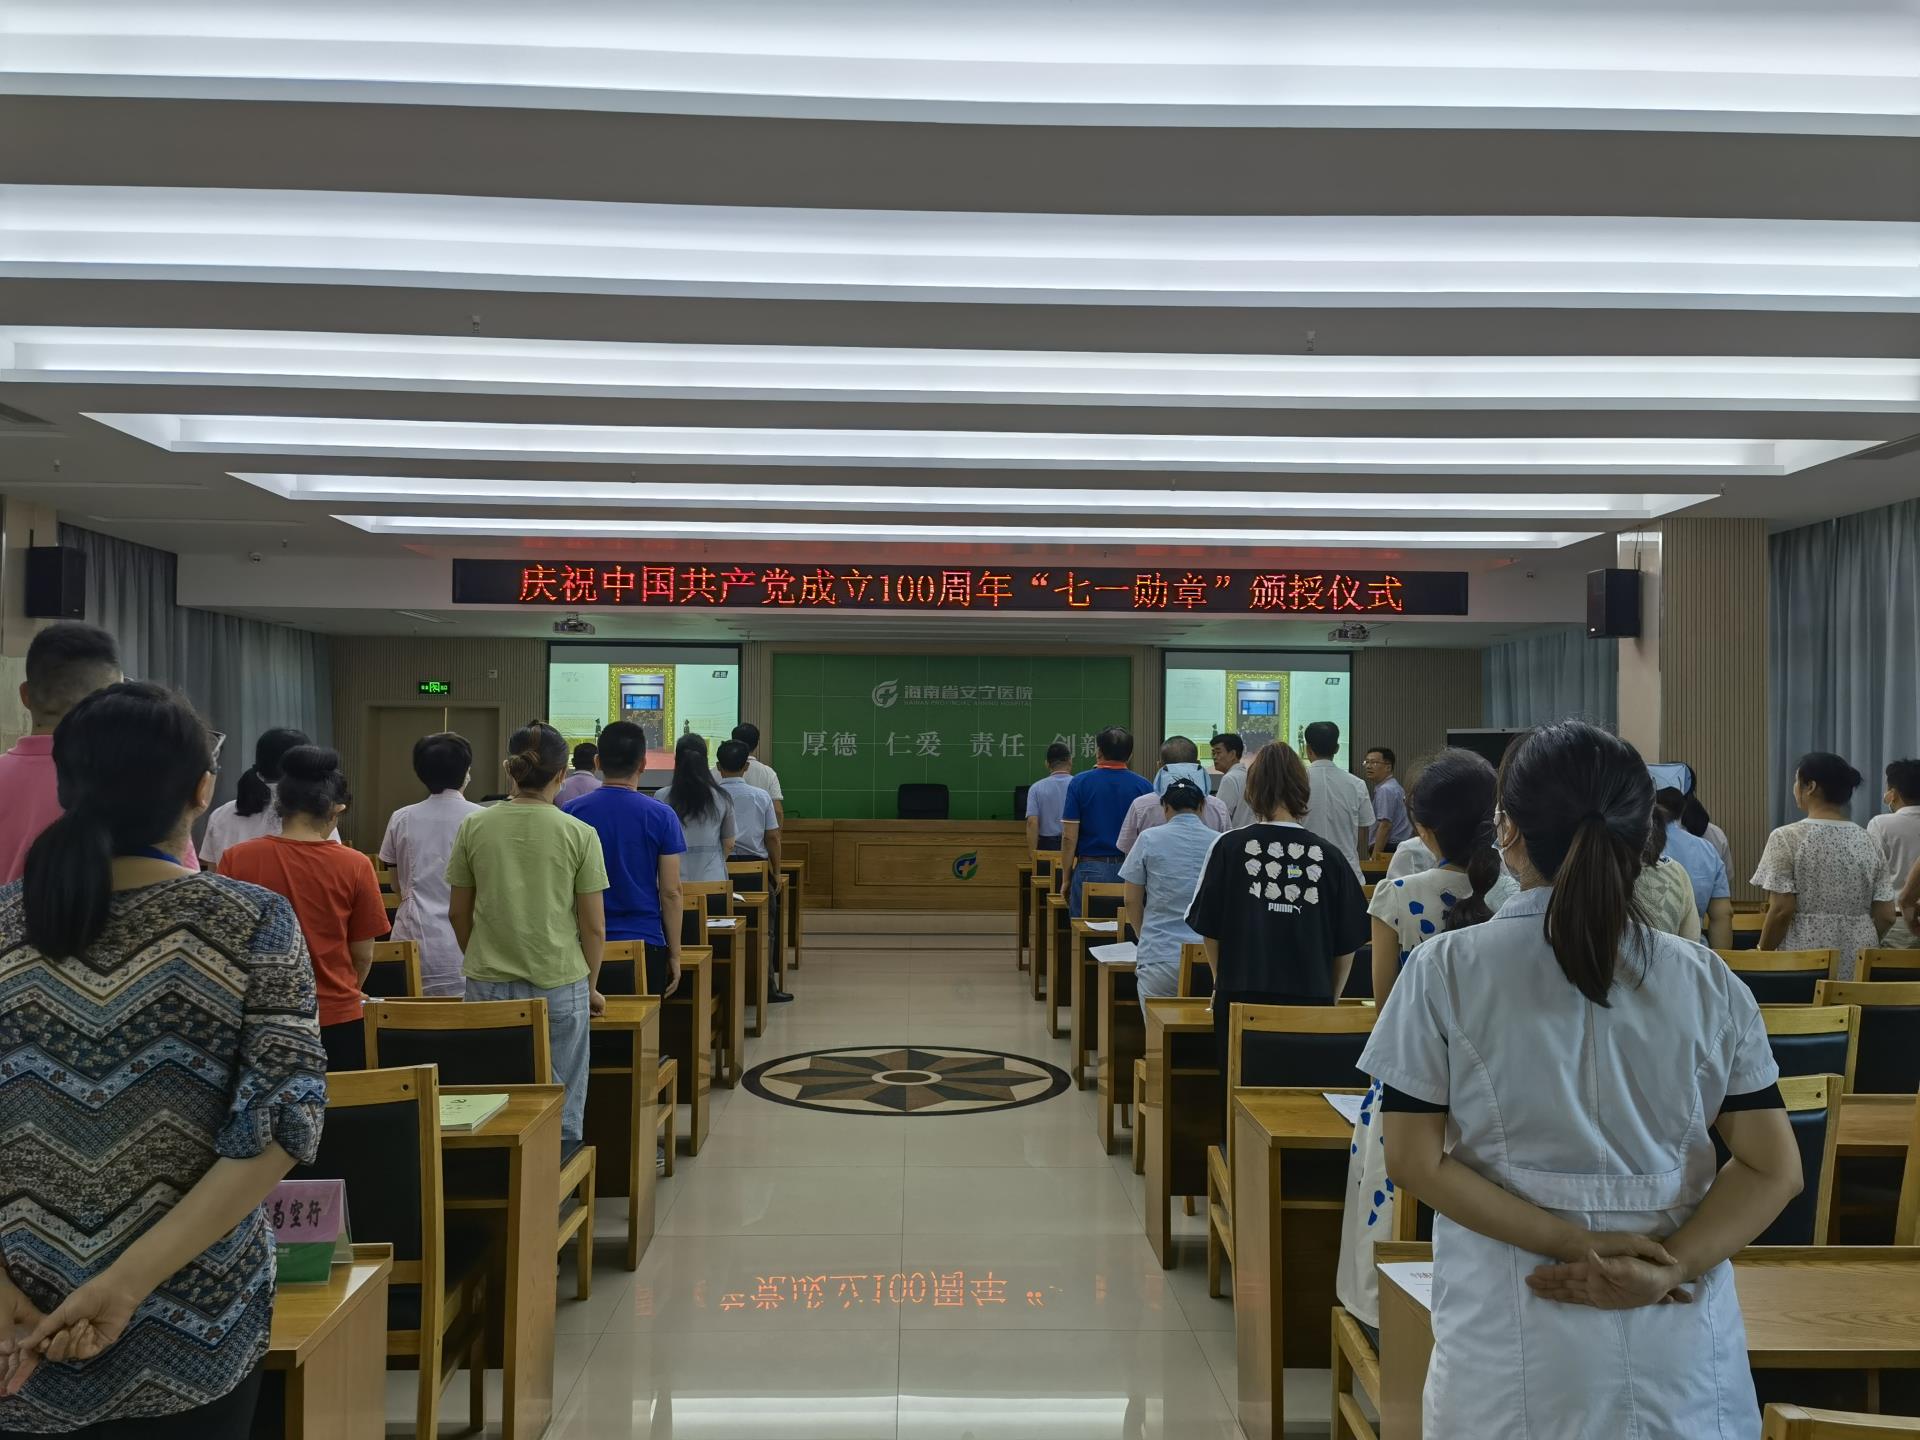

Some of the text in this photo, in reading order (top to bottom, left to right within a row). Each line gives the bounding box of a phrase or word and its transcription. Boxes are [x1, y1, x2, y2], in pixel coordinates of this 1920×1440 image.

[904, 685, 1033, 700] 海南省安宁医院
[801, 730, 858, 757] 厚德
[886, 731, 942, 757] 仁爱
[969, 732, 1025, 758] 责任
[1268, 902, 1293, 913] PUMA
